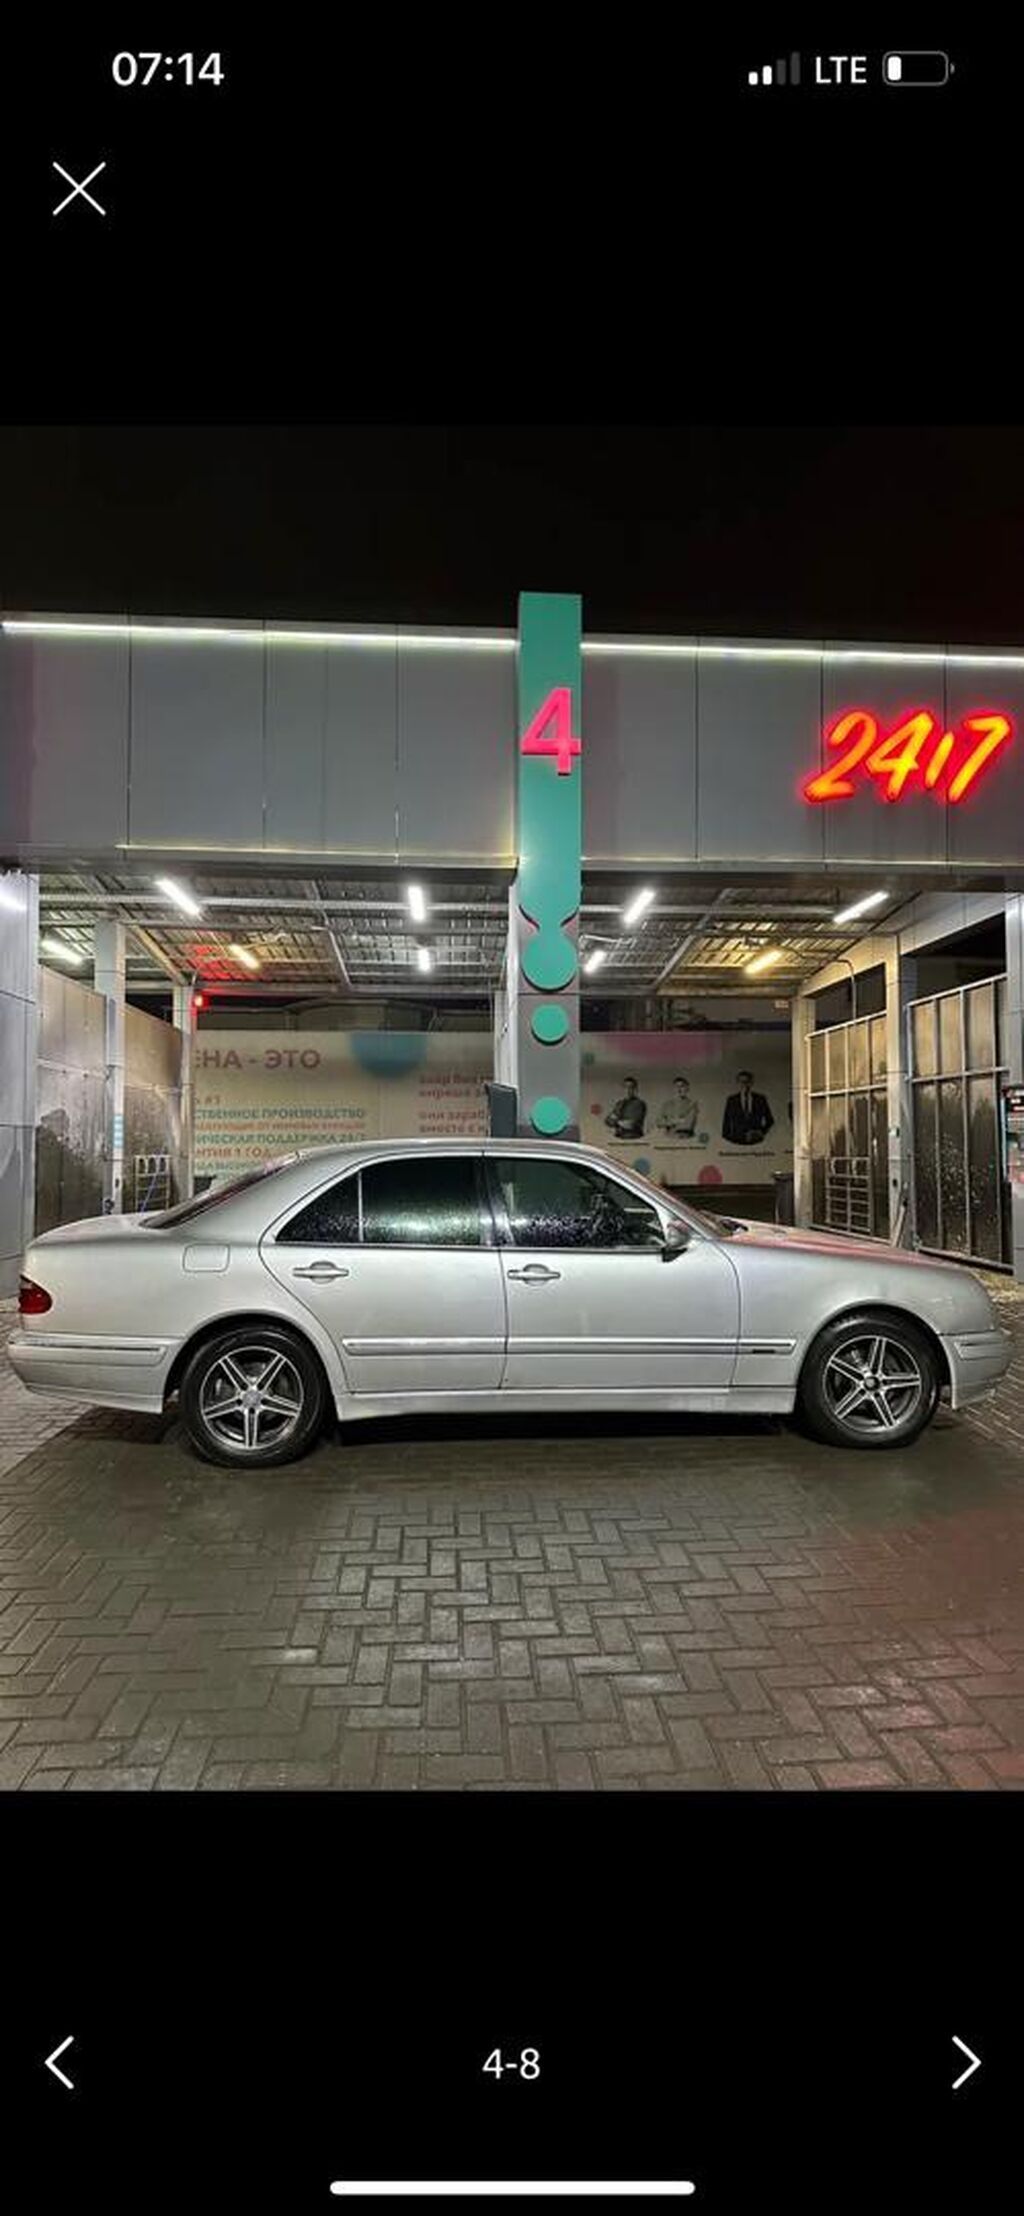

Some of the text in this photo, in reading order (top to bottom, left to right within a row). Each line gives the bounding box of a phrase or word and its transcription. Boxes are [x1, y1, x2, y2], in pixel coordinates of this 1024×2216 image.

[520, 687, 581, 777] 4
[805, 710, 1011, 803] 24/7
[265, 1049, 321, 1069] ЭТО
[262, 1108, 365, 1119] ПРОИЗВОДСТВО
